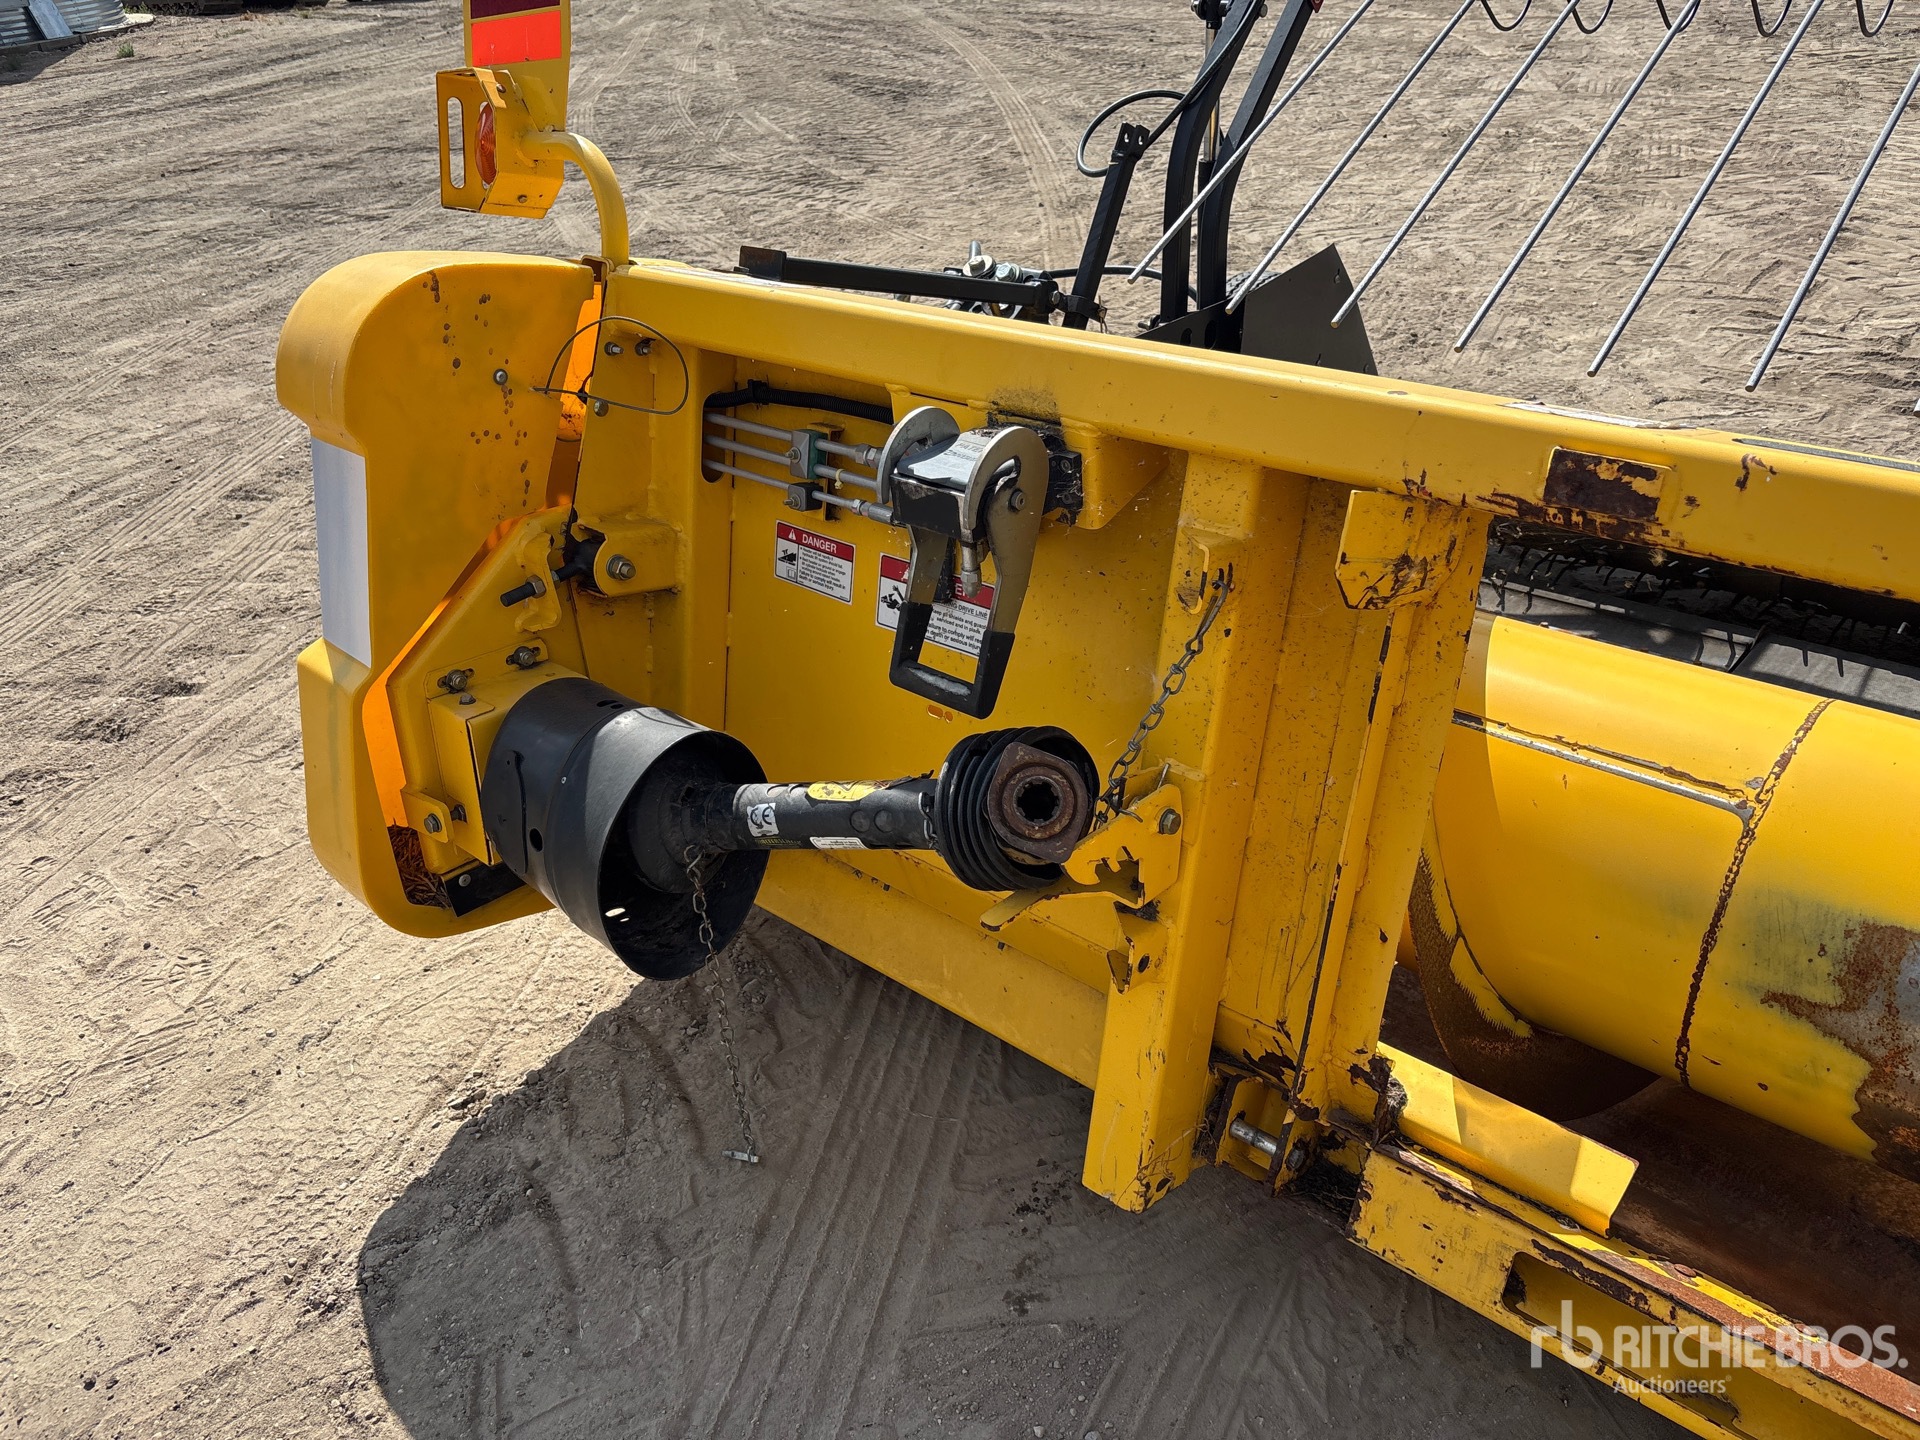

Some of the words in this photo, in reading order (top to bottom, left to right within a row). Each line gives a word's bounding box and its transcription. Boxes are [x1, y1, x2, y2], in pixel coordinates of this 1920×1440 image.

[802, 534, 837, 553] DANGER
[958, 605, 974, 614] DRIVE
[936, 617, 954, 626] serviced
[948, 614, 964, 623] shields
[930, 630, 943, 639] death
[950, 637, 968, 646] serious
[948, 629, 965, 639] comply
